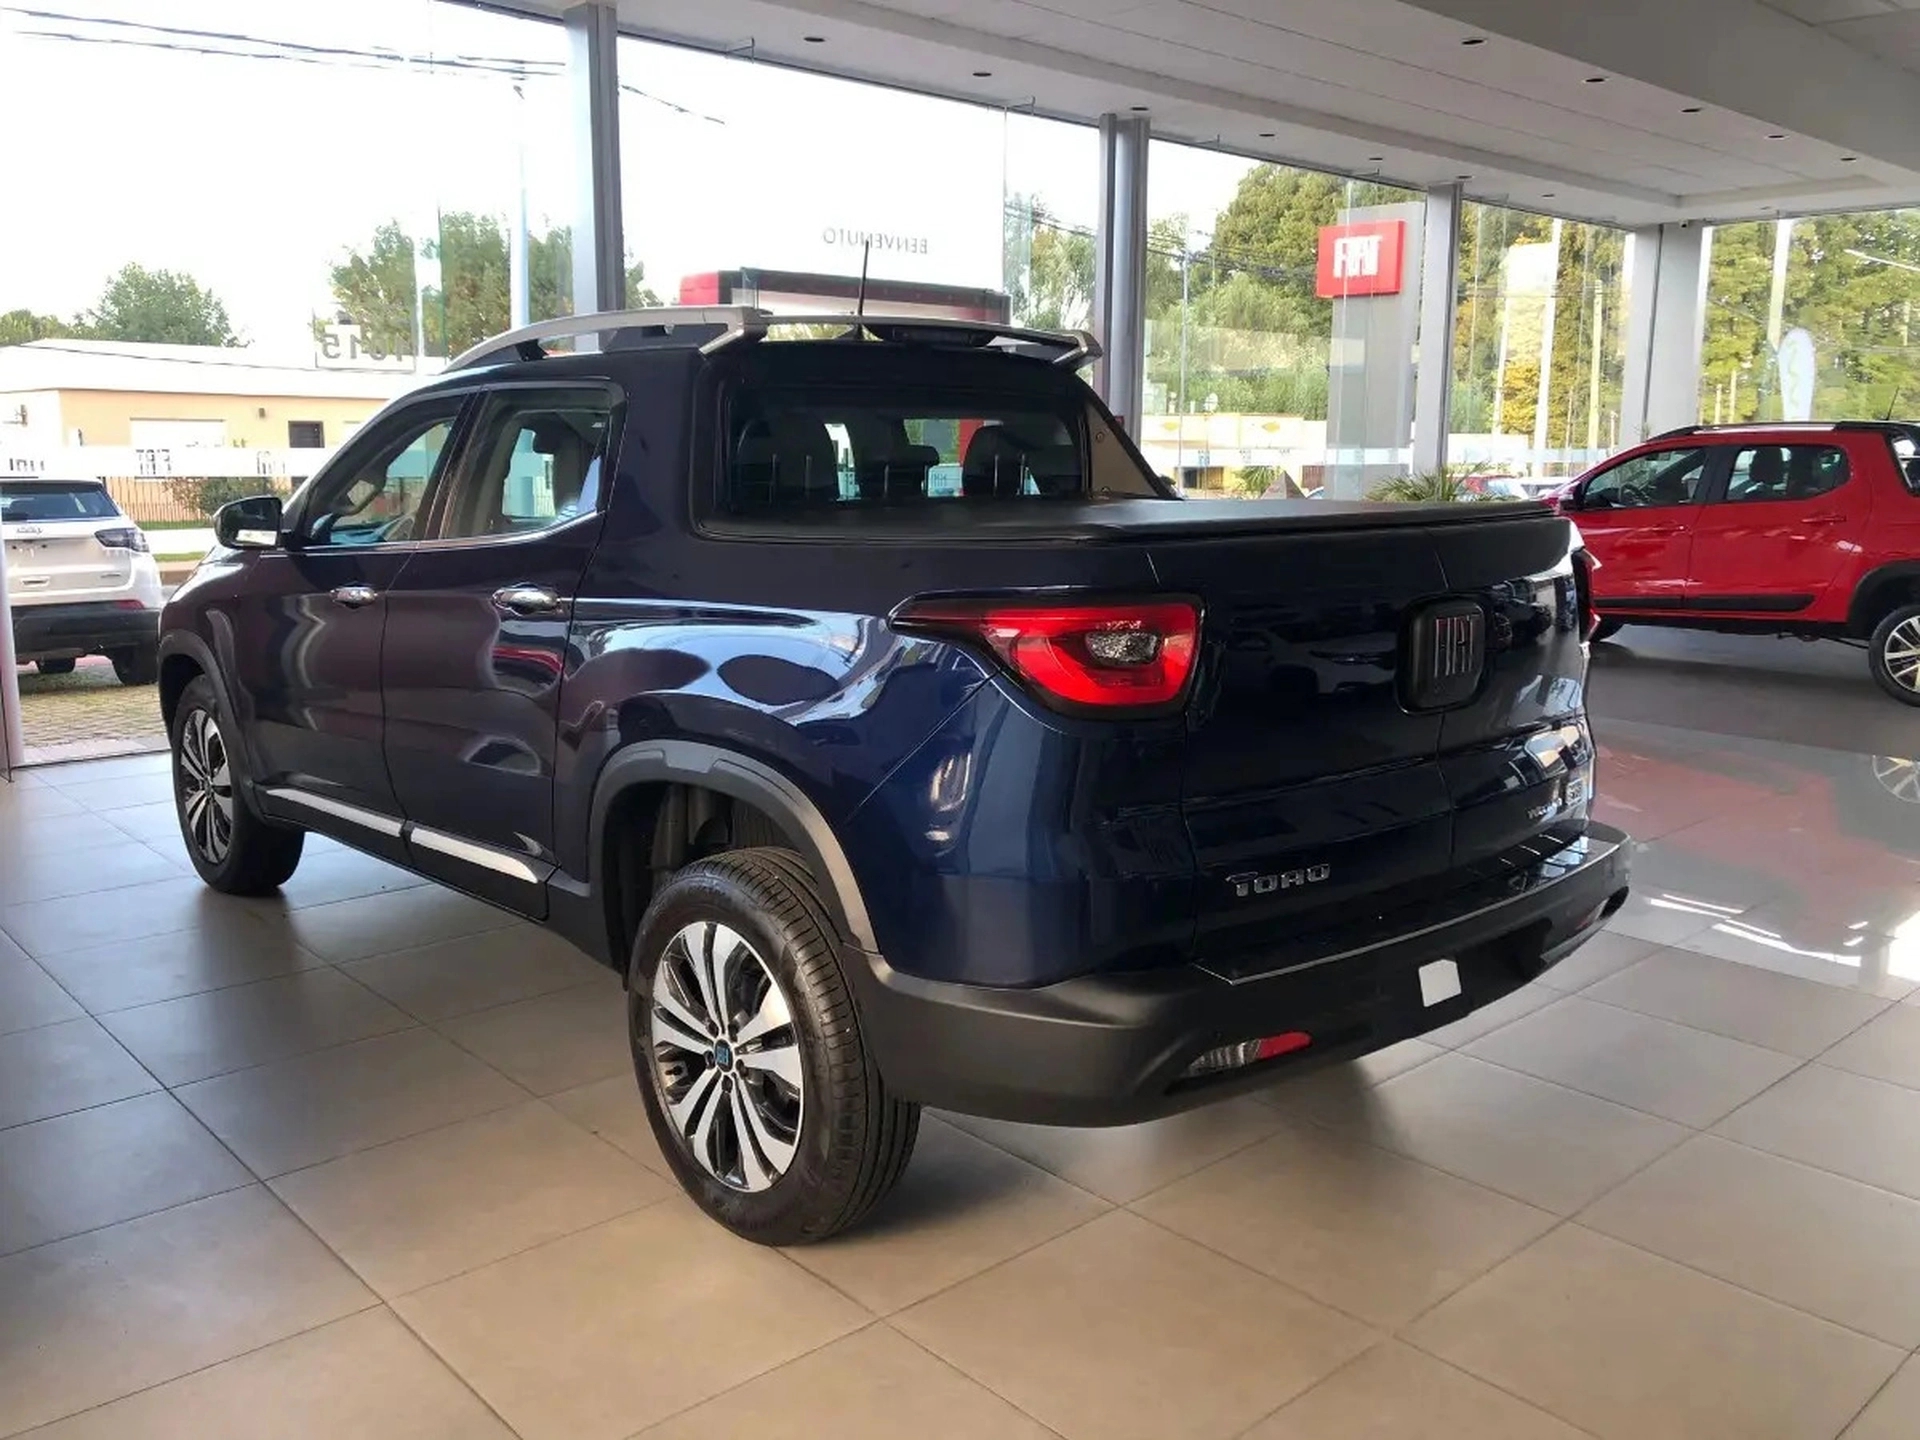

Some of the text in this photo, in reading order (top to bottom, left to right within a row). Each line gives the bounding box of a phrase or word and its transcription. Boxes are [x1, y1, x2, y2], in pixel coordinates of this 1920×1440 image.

[1333, 235, 1382, 278] FIAT
[1434, 614, 1479, 678] FIAT
[1225, 863, 1330, 897] TORO
